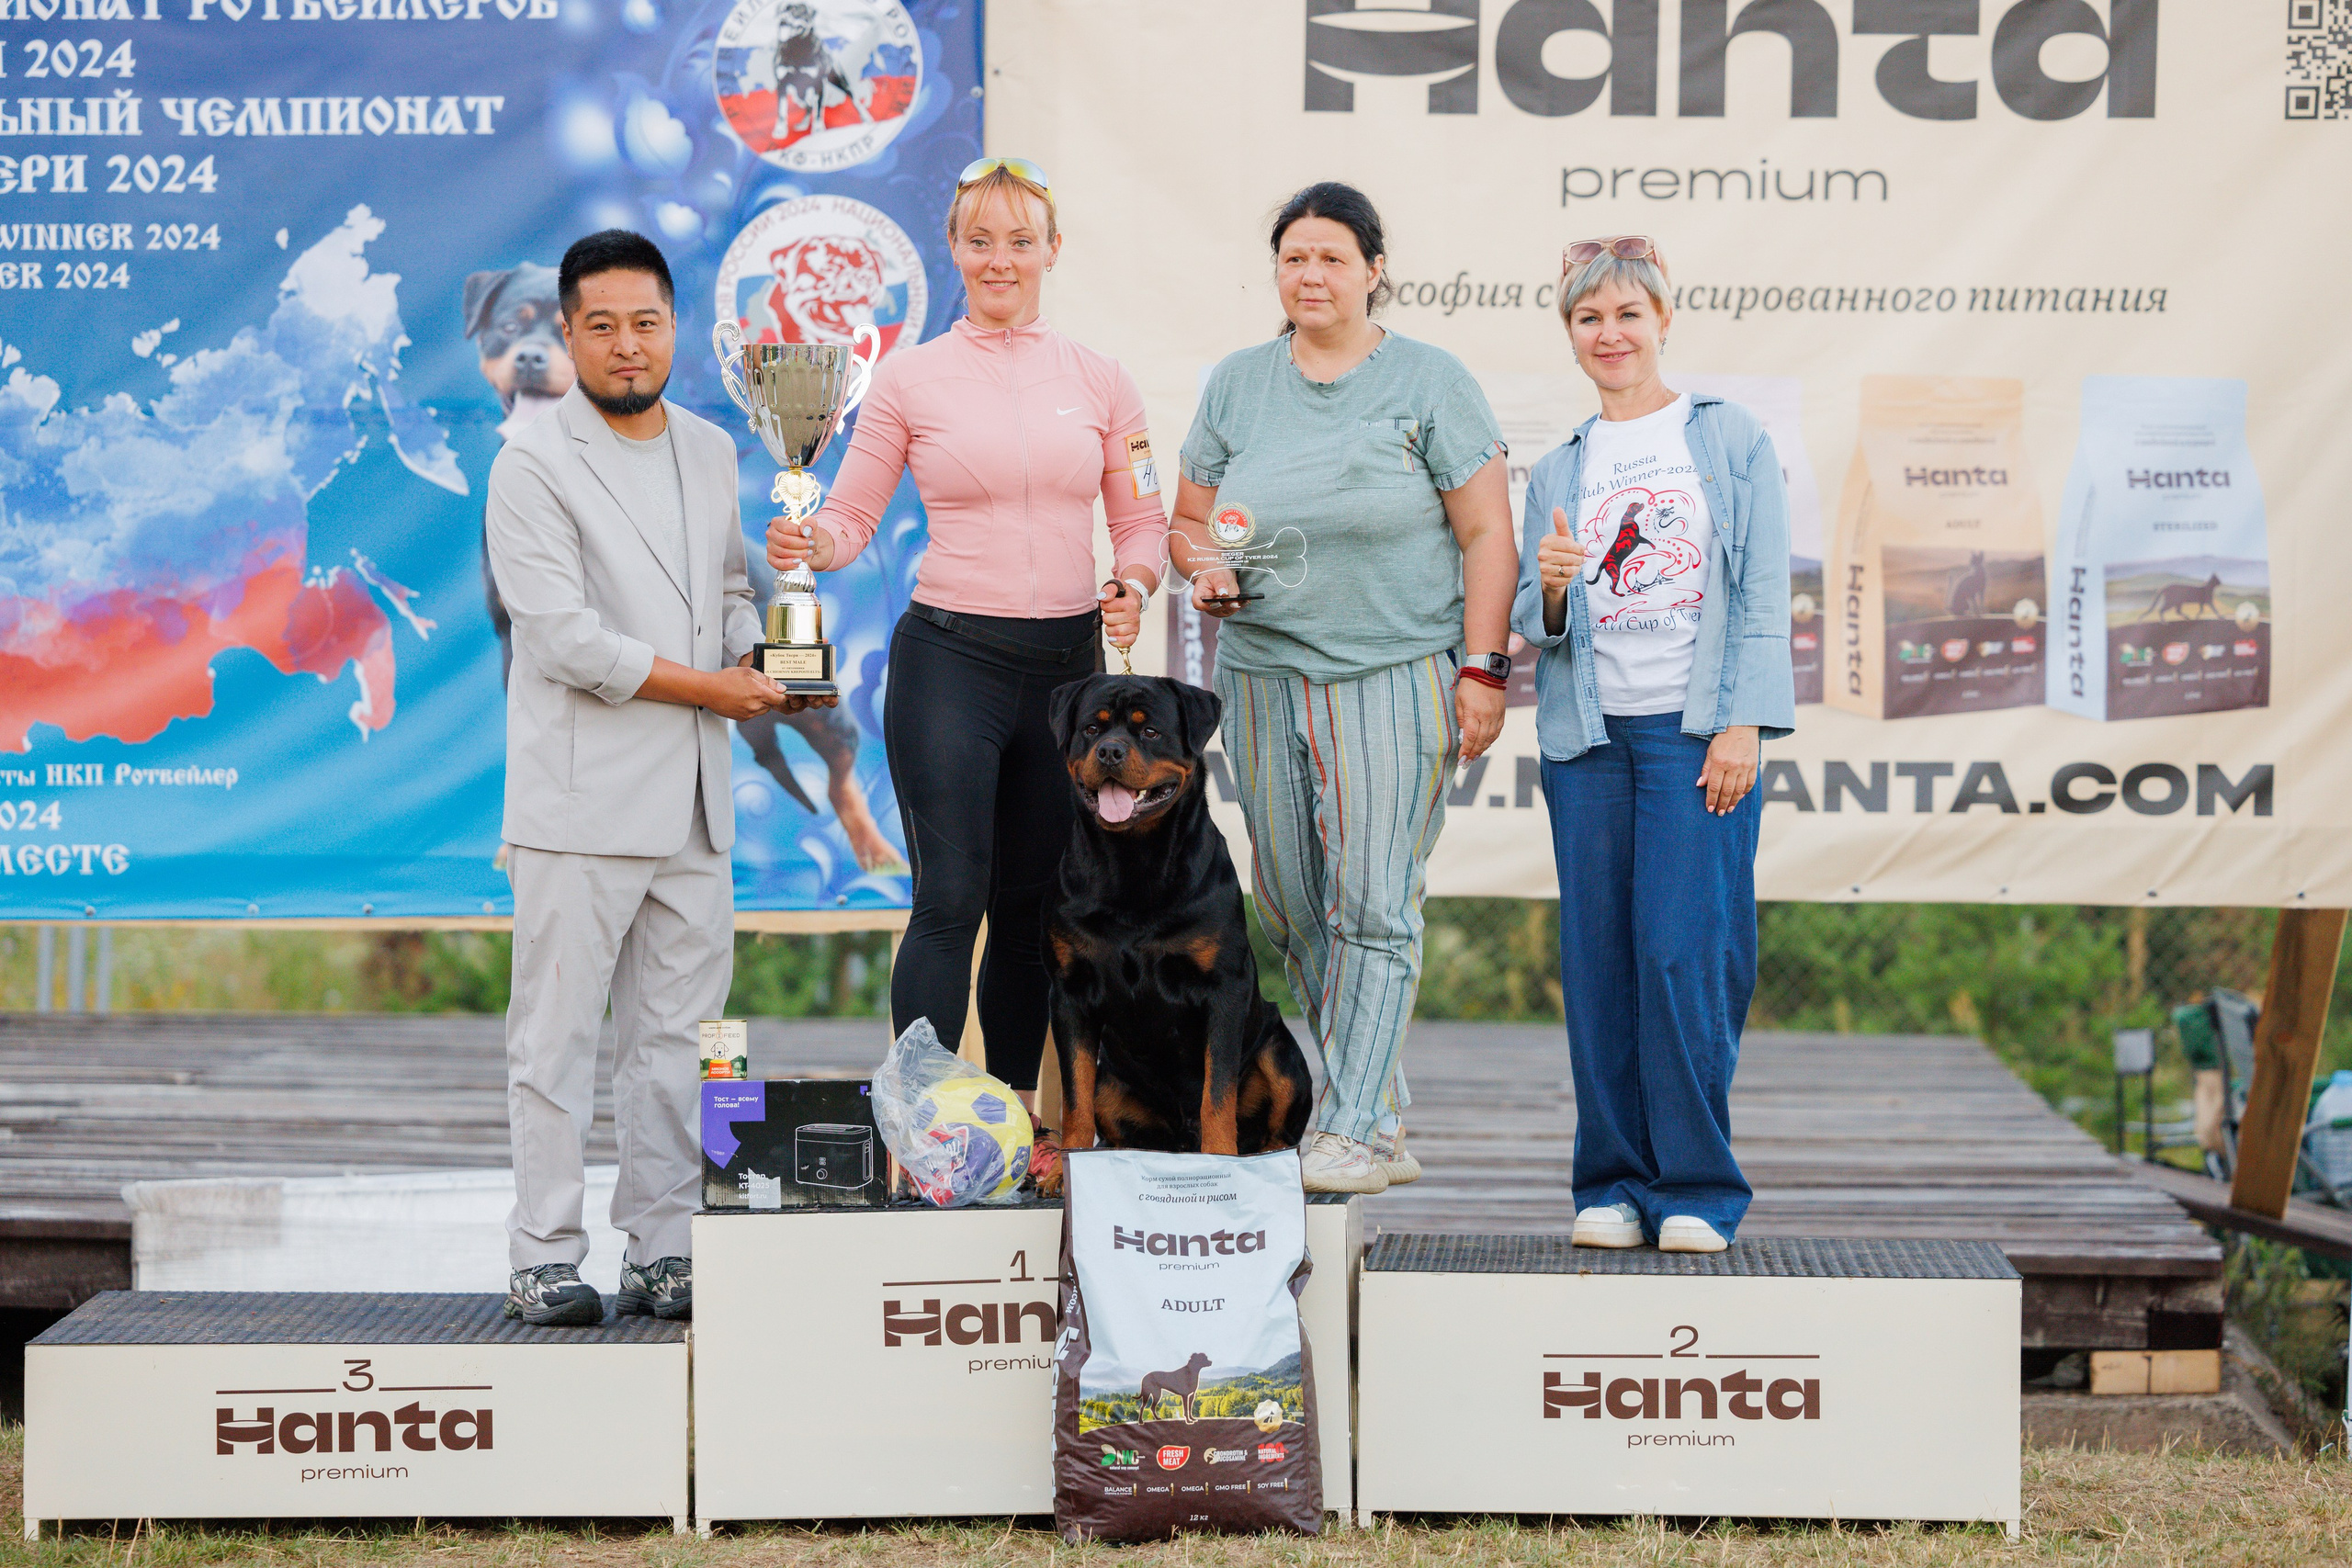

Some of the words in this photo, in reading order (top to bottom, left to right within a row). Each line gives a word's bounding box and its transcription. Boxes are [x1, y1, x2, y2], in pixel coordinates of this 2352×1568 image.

[24, 39, 137, 78] 2024
[1305, 0, 2156, 120] Hanta
[159, 95, 504, 137] ЧЕМПИОНАТ
[106, 153, 219, 193] 2024
[1560, 158, 1889, 208] premium
[775, 199, 821, 222] 2024
[145, 222, 221, 251] 2024
[55, 261, 130, 289] 2024
[1396, 271, 1522, 315] софия
[1536, 279, 1956, 320] ссированного
[1968, 284, 2168, 313] питания
[1612, 455, 1657, 475] Russia
[1905, 466, 2008, 486] Hanta
[2126, 468, 2232, 489] Hanta
[1581, 482, 1605, 501] lub
[1626, 616, 1659, 633] Cup
[1664, 607, 1678, 631] of
[1848, 564, 1865, 698] Hanta
[2069, 566, 2087, 700] Hanta
[46, 763, 104, 786] НКП
[115, 763, 239, 791] Ротвейлер
[1159, 1174, 1176, 1182] сухой
[1177, 1172, 1231, 1182] полнорационный
[1145, 1193, 1197, 1203] говядиной
[1206, 1193, 1237, 1204] рисом
[1114, 1224, 1266, 1257] Hanta
[1010, 1250, 1035, 1282] 1
[1159, 1261, 1220, 1271] premium
[1160, 1298, 1226, 1313] ADULT
[883, 1298, 1057, 1347] Han
[1669, 1325, 1699, 1358] 2
[343, 1359, 375, 1392] 3
[968, 1354, 1052, 1374] premiu
[1544, 1369, 1820, 1420] Hanta
[216, 1400, 493, 1455] Hanta
[1627, 1430, 1736, 1449] premium
[1116, 1450, 1139, 1465] NWC
[1162, 1450, 1184, 1458] FRESH
[1162, 1458, 1180, 1466] MEAT
[301, 1464, 409, 1483] premium
